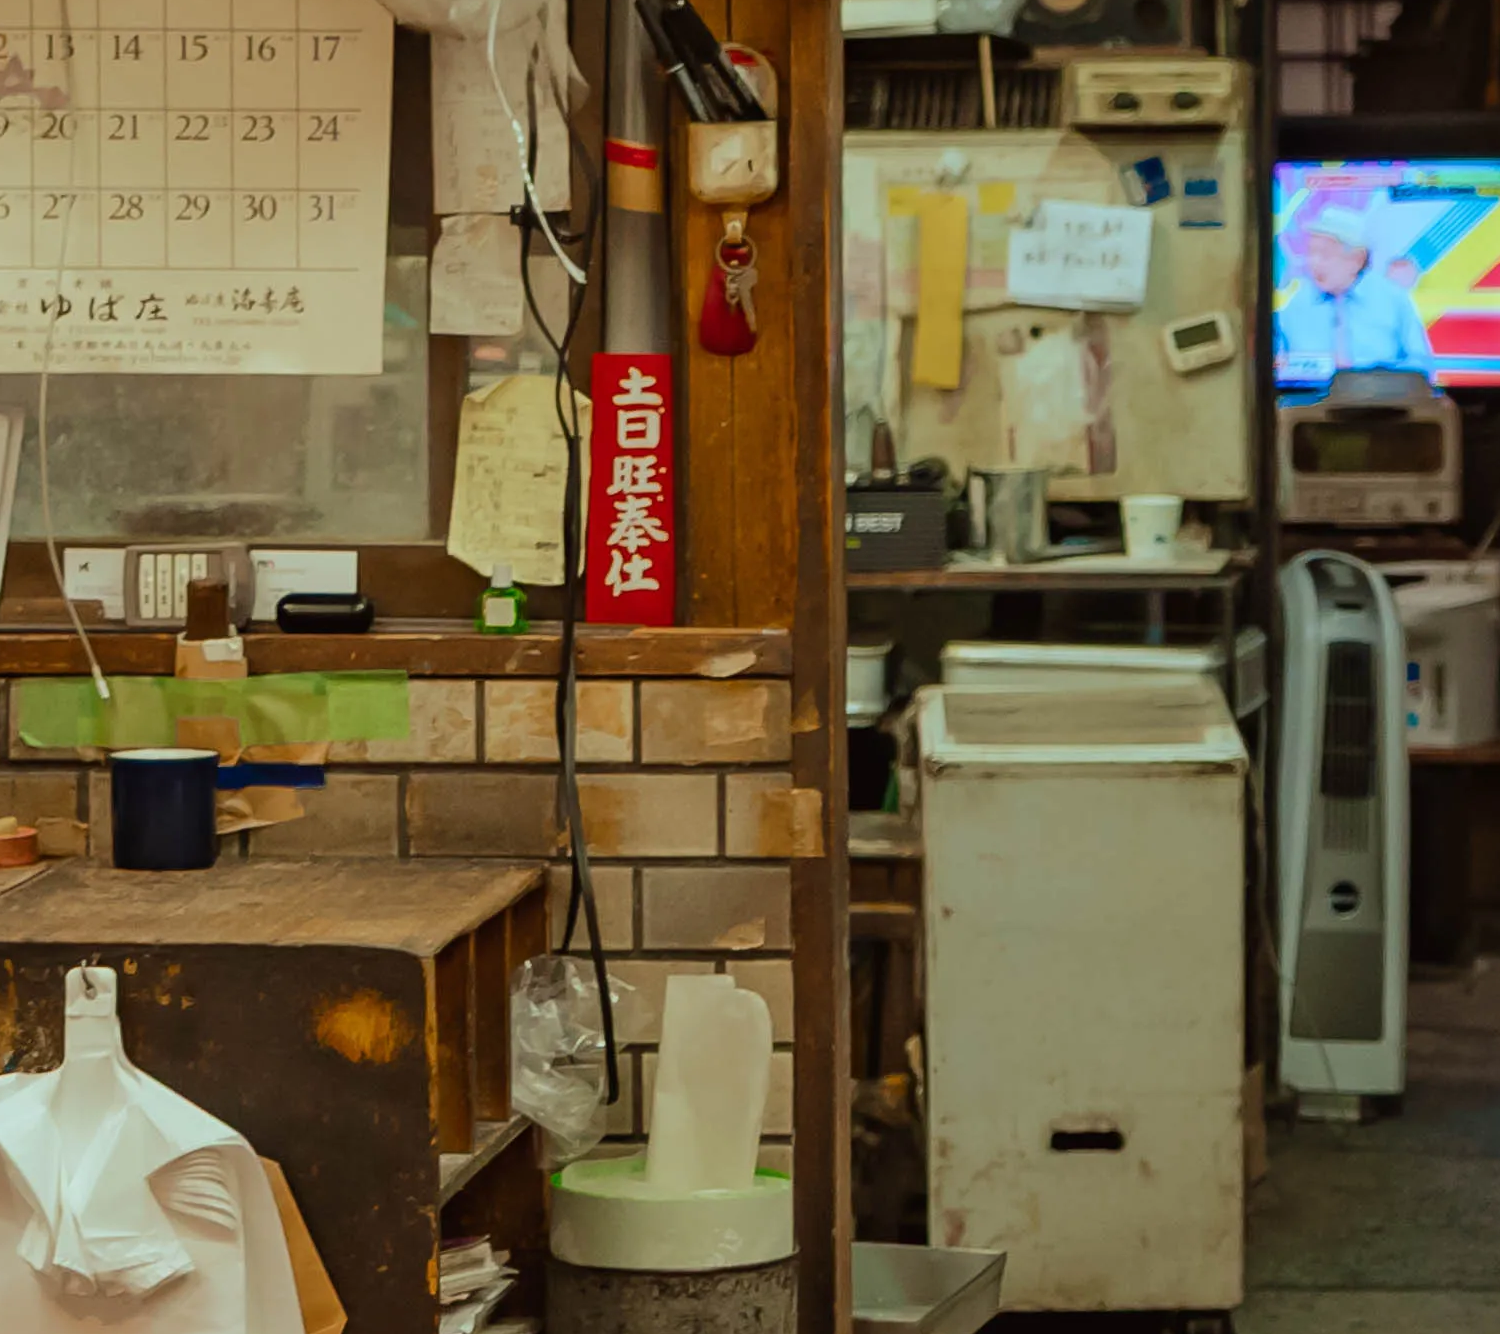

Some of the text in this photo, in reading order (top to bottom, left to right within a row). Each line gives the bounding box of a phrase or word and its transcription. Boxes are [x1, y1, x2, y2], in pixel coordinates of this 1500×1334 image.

[46, 34, 75, 60] 13
[112, 34, 143, 61] 14
[178, 35, 208, 61] 15
[244, 36, 276, 62] 16
[312, 36, 341, 62] 17
[41, 113, 77, 140] 20
[108, 114, 139, 140] 21
[174, 115, 210, 141] 22
[241, 115, 276, 142] 23
[306, 115, 341, 142] 24
[42, 193, 77, 220] 27
[108, 194, 145, 221] 28
[174, 194, 211, 221] 29
[243, 194, 277, 222] 30
[308, 195, 336, 222] 31
[854, 512, 905, 533] BEST
